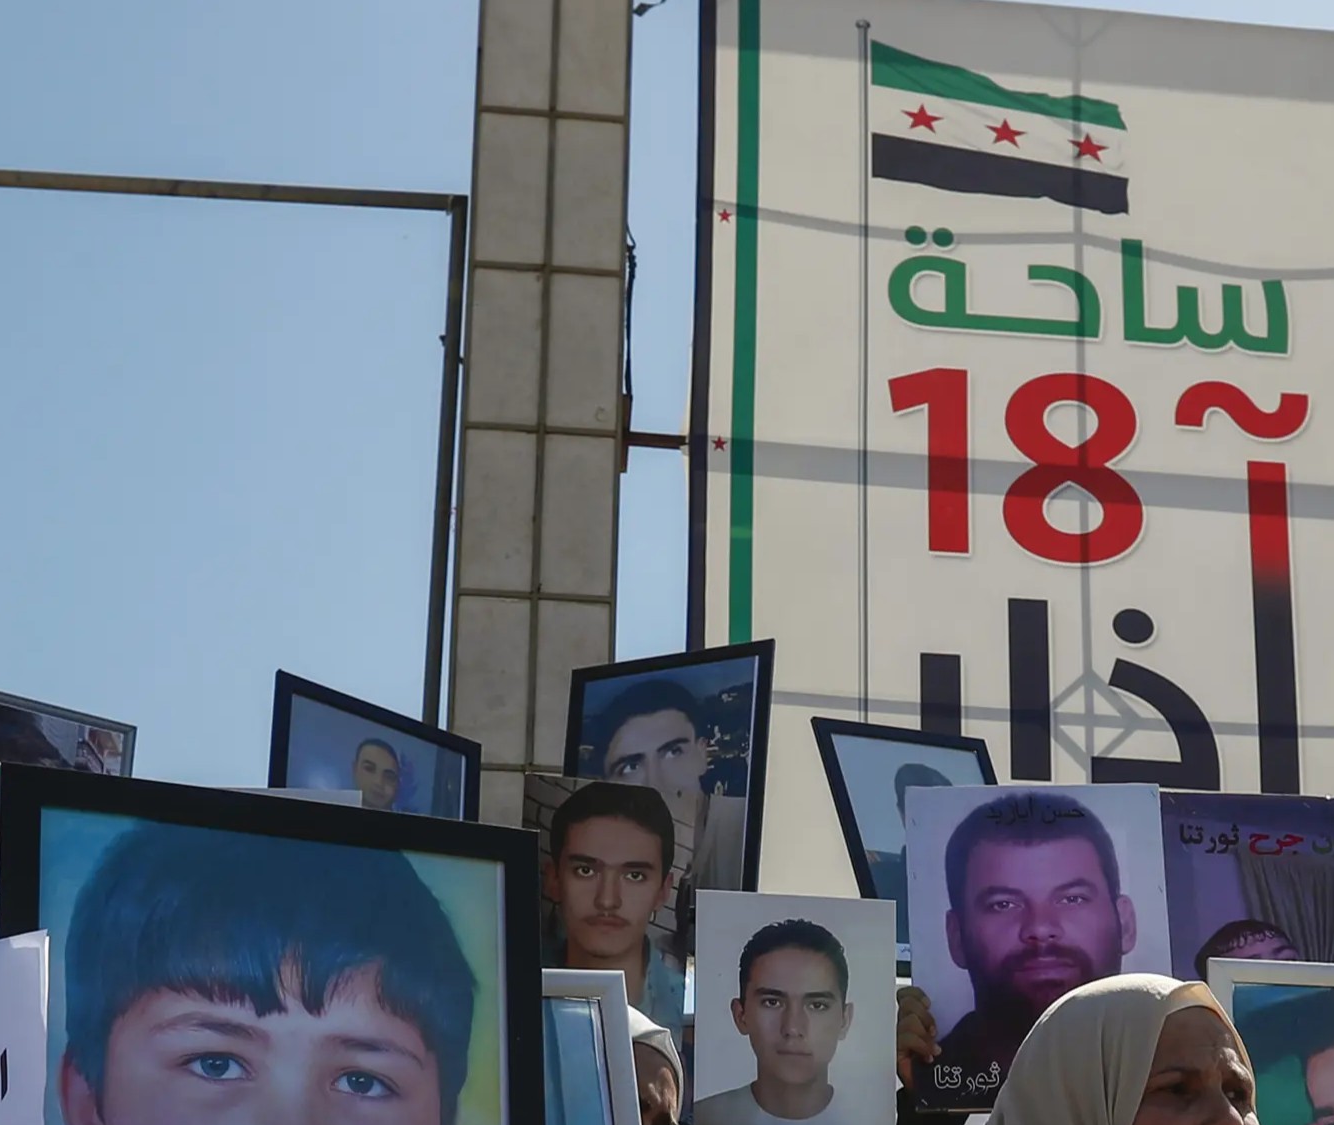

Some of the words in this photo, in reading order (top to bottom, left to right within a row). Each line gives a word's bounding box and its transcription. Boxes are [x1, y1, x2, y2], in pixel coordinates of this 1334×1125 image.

[887, 225, 1290, 355] ساحة
[887, 367, 1145, 564] 18
[1178, 823, 1240, 854] ثورتنا
[1248, 832, 1304, 855] جرح
[933, 1061, 1002, 1095] ثورتنا
